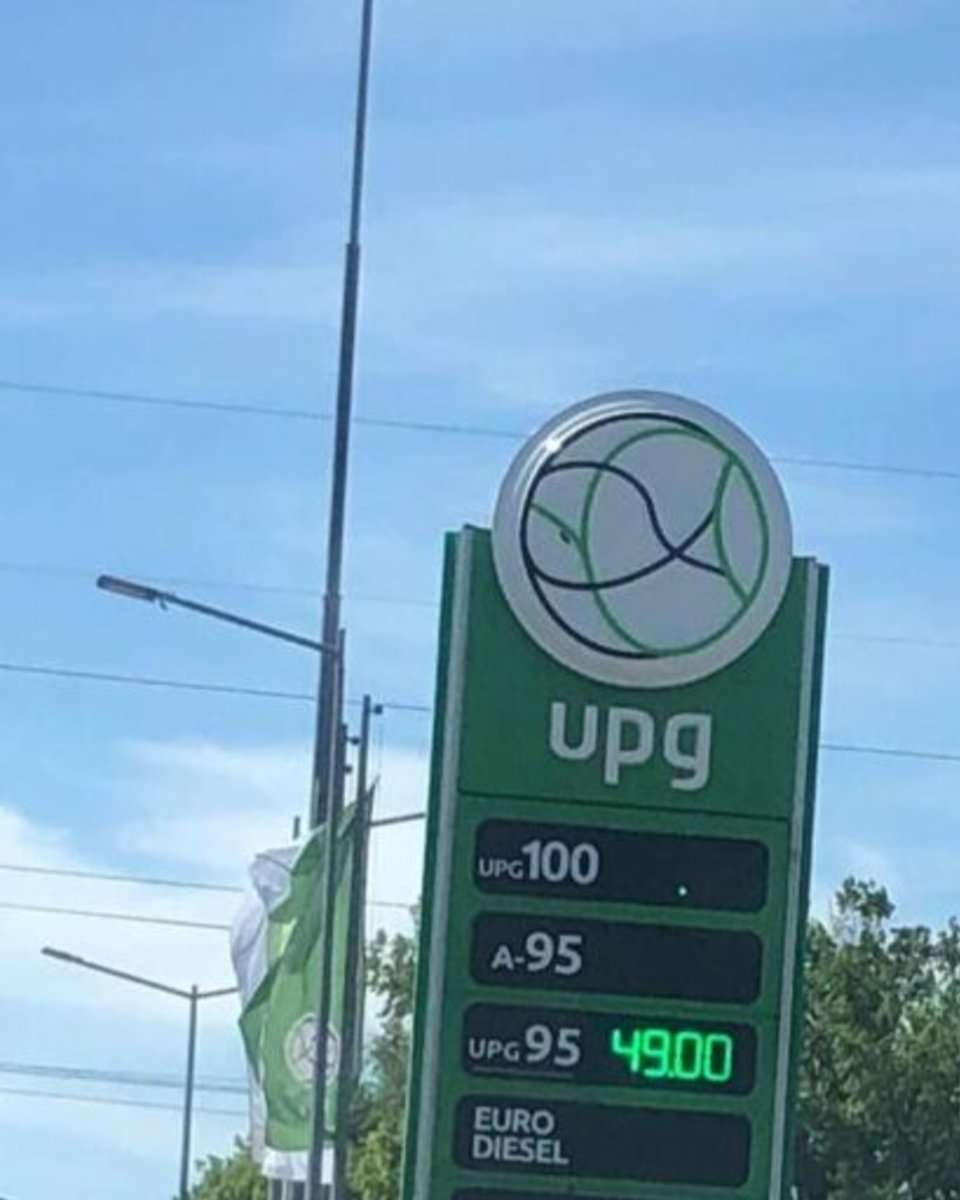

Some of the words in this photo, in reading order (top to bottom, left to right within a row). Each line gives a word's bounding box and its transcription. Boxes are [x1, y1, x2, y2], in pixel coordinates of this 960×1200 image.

[550, 702, 713, 790] upg
[611, 1028, 733, 1083] 49.00
[473, 1105, 555, 1136] EURO
[471, 1134, 570, 1165] DIESEL
